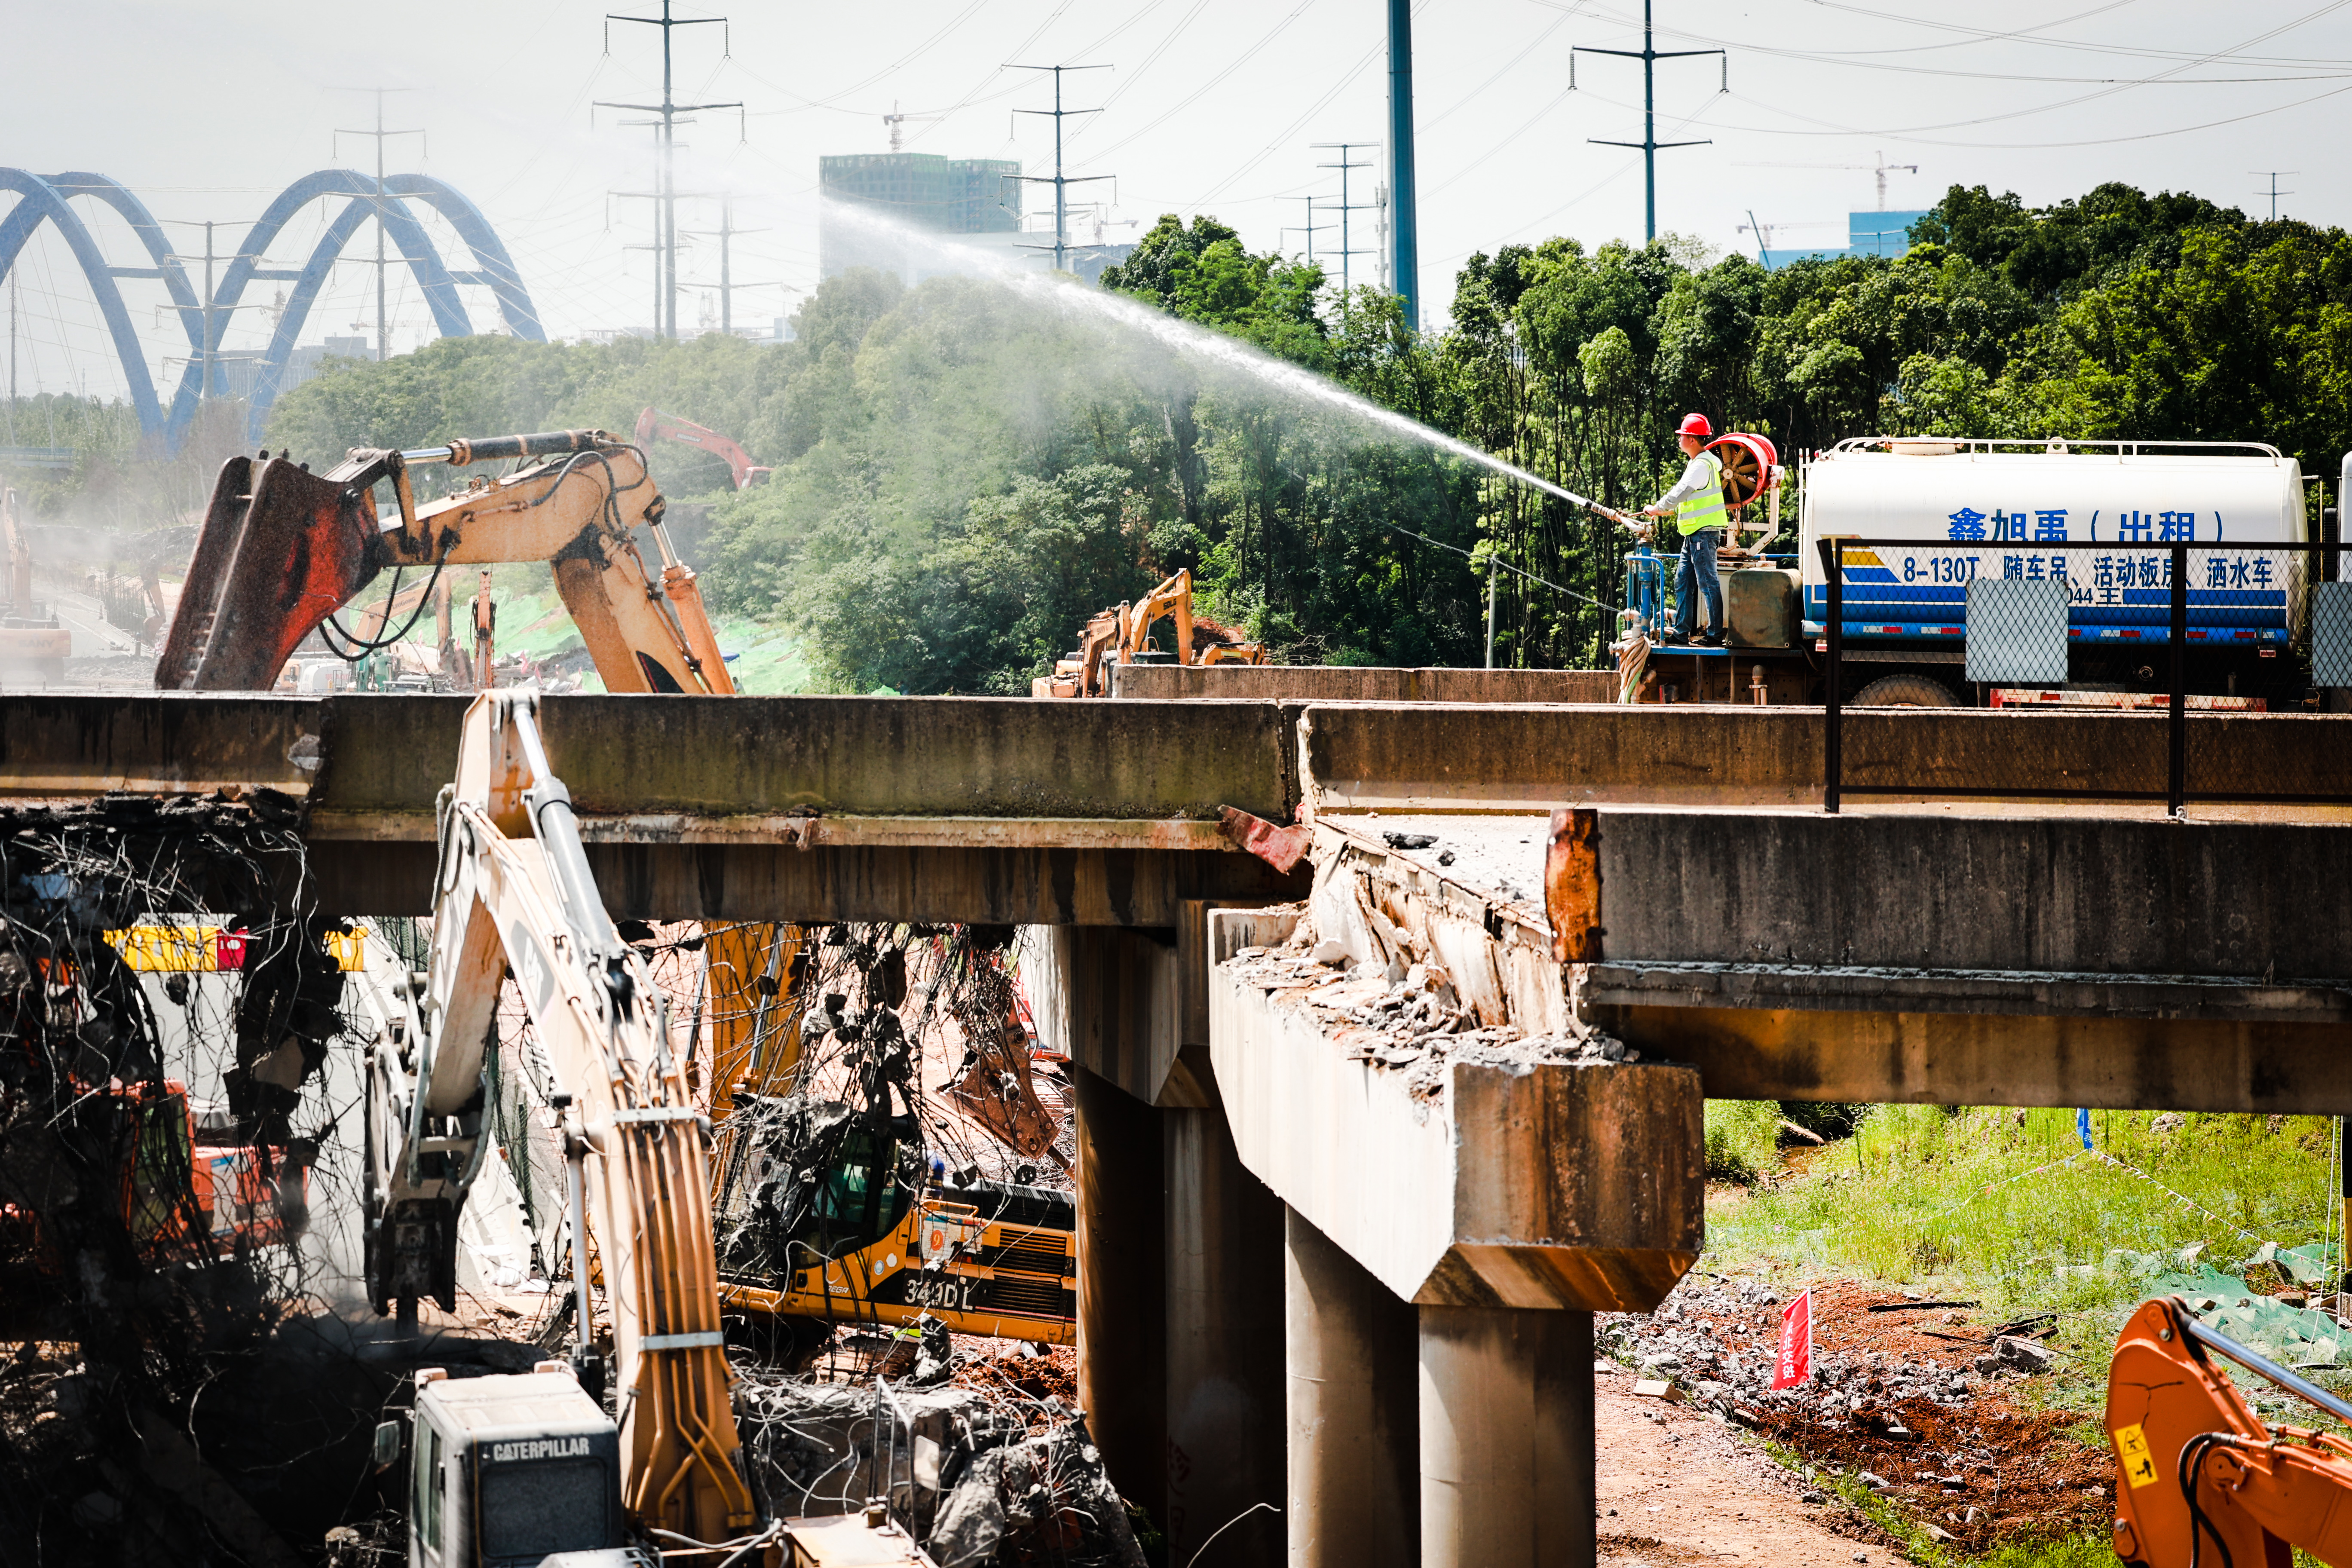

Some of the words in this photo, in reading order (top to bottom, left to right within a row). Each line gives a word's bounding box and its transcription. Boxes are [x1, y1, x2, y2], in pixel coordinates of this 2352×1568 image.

[1163, 598, 1177, 610] SDLG
[18, 639, 55, 648] SANY
[933, 1234, 940, 1246] 9
[493, 1437, 590, 1462] CATERPILLAR
